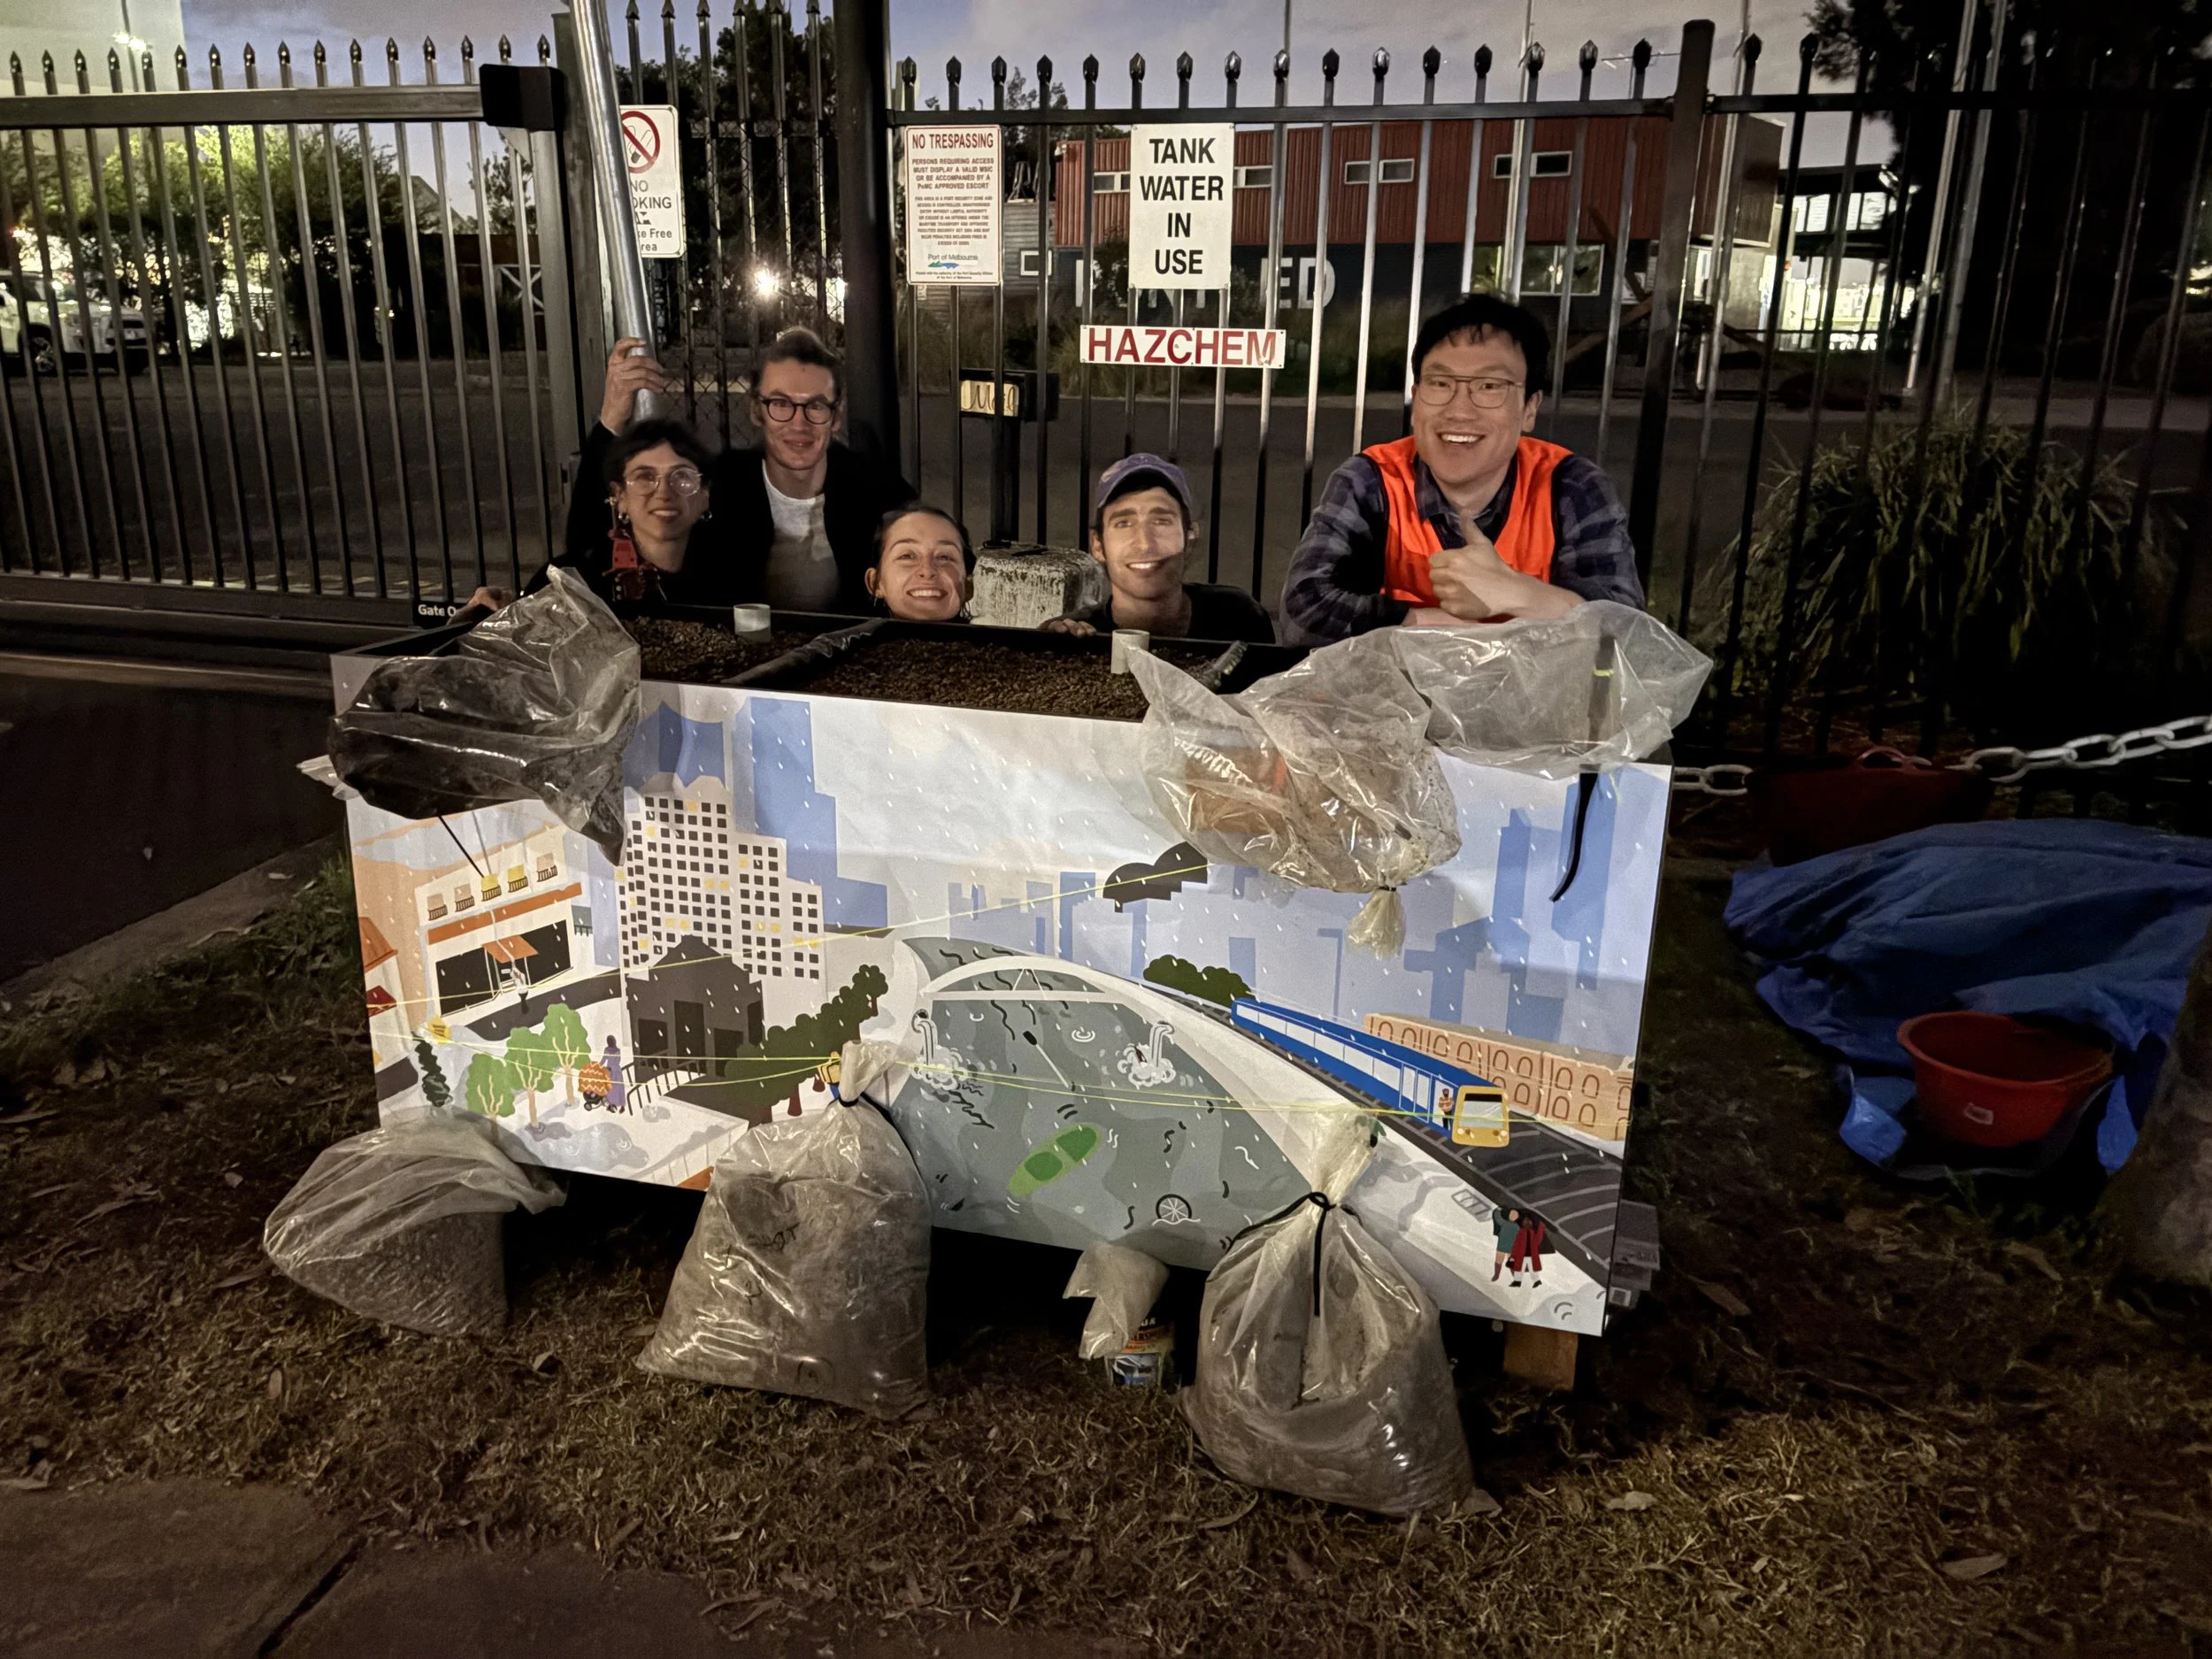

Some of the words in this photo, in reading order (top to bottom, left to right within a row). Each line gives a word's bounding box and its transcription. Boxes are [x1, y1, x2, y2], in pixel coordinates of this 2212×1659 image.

[912, 134, 926, 149] NO
[929, 133, 994, 149] TRESPASSING
[1149, 137, 1216, 164] TANK
[1140, 176, 1224, 201] WATER
[649, 228, 672, 238] Free
[1167, 212, 1191, 237] IN
[1155, 250, 1203, 274] USE
[1088, 327, 1277, 366] HAZCHEM
[418, 603, 446, 617] Gate
